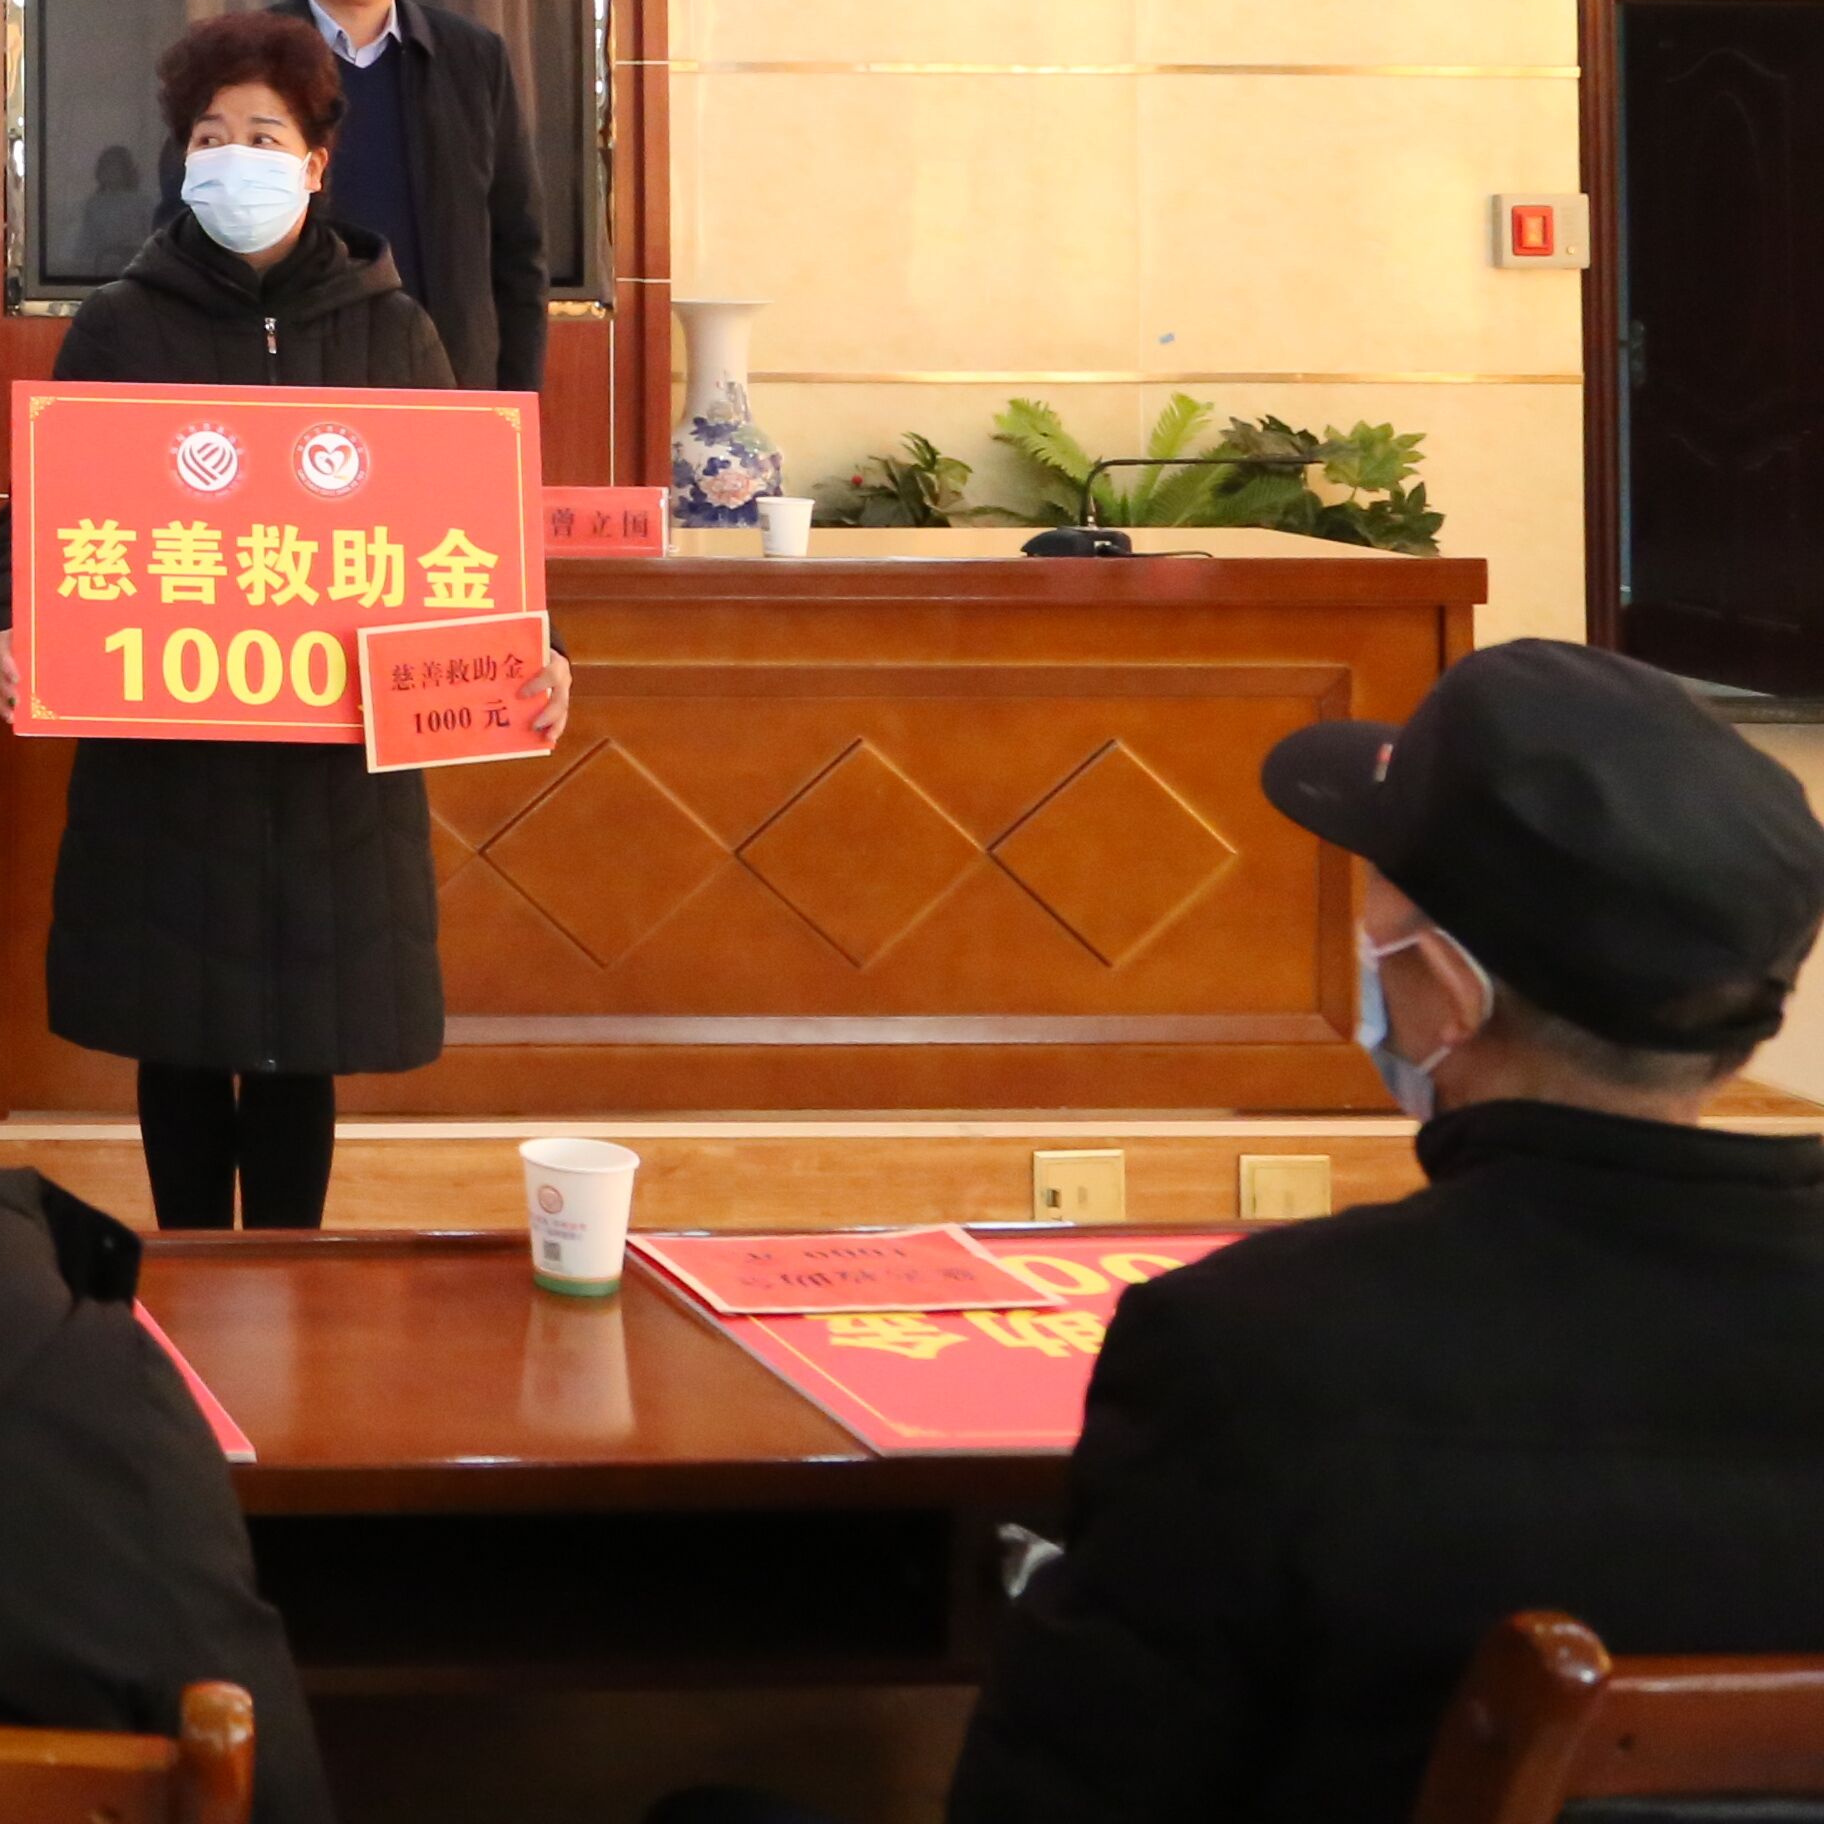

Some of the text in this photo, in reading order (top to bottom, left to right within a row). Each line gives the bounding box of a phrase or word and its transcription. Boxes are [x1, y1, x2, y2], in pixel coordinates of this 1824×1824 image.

[56, 518, 500, 610] 慈善救助金
[104, 627, 362, 707] 1000
[391, 653, 525, 692] 慈善救助金
[413, 698, 511, 734] 1000 元
